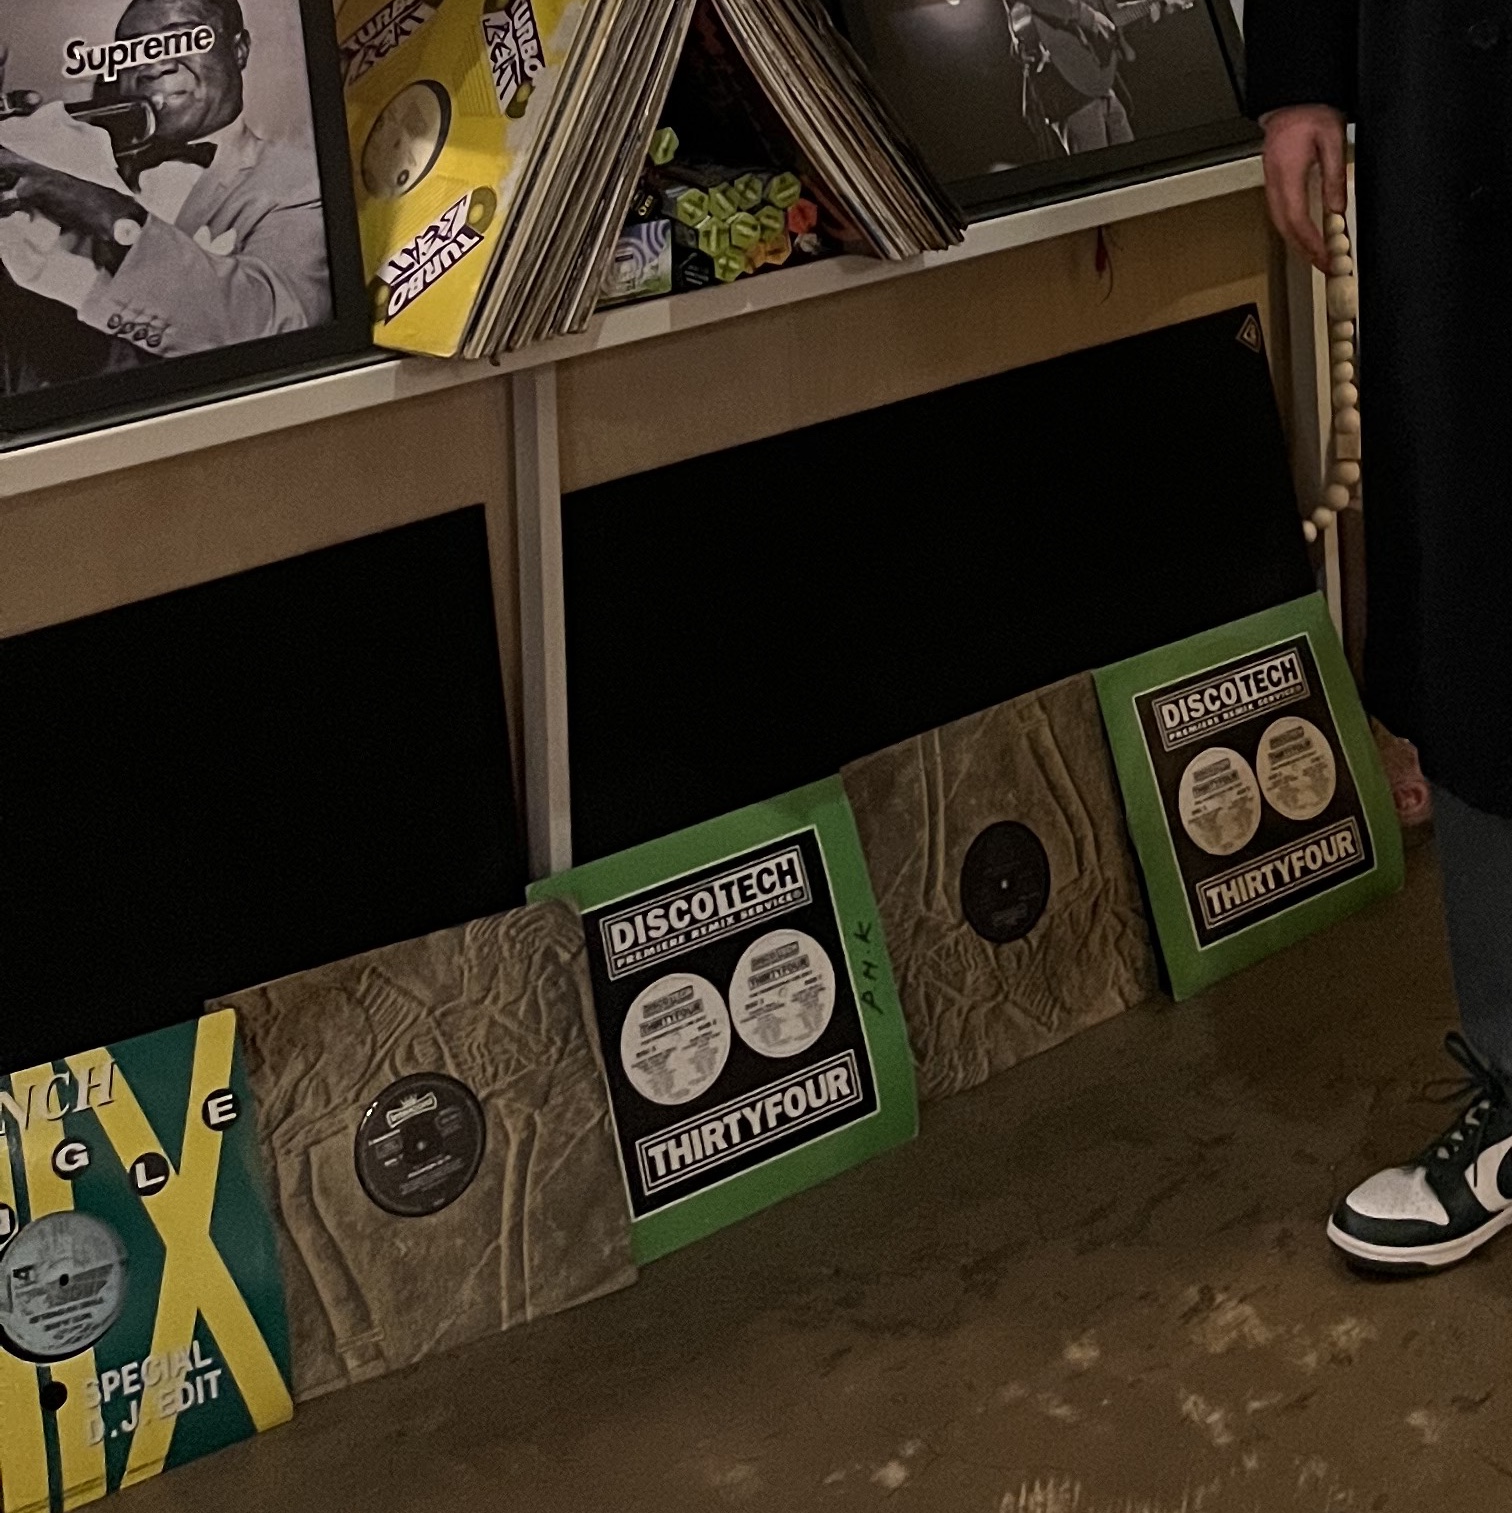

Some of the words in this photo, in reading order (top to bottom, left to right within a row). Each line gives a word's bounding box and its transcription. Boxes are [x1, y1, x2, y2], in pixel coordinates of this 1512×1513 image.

[65, 25, 214, 80] Supreme
[388, 232, 482, 317] TURBO
[1161, 657, 1299, 729] DISCOTECH
[611, 857, 799, 954] DISCOTECH
[1205, 830, 1357, 915] THIRTYFOUR
[616, 933, 688, 968] PREMIERE
[691, 915, 736, 940] REMIX
[740, 893, 794, 920] SERVICE
[647, 1065, 852, 1177] THIRTYFOUR
[85, 1340, 213, 1410] SPECIAL
[160, 1369, 222, 1420] EDIT
